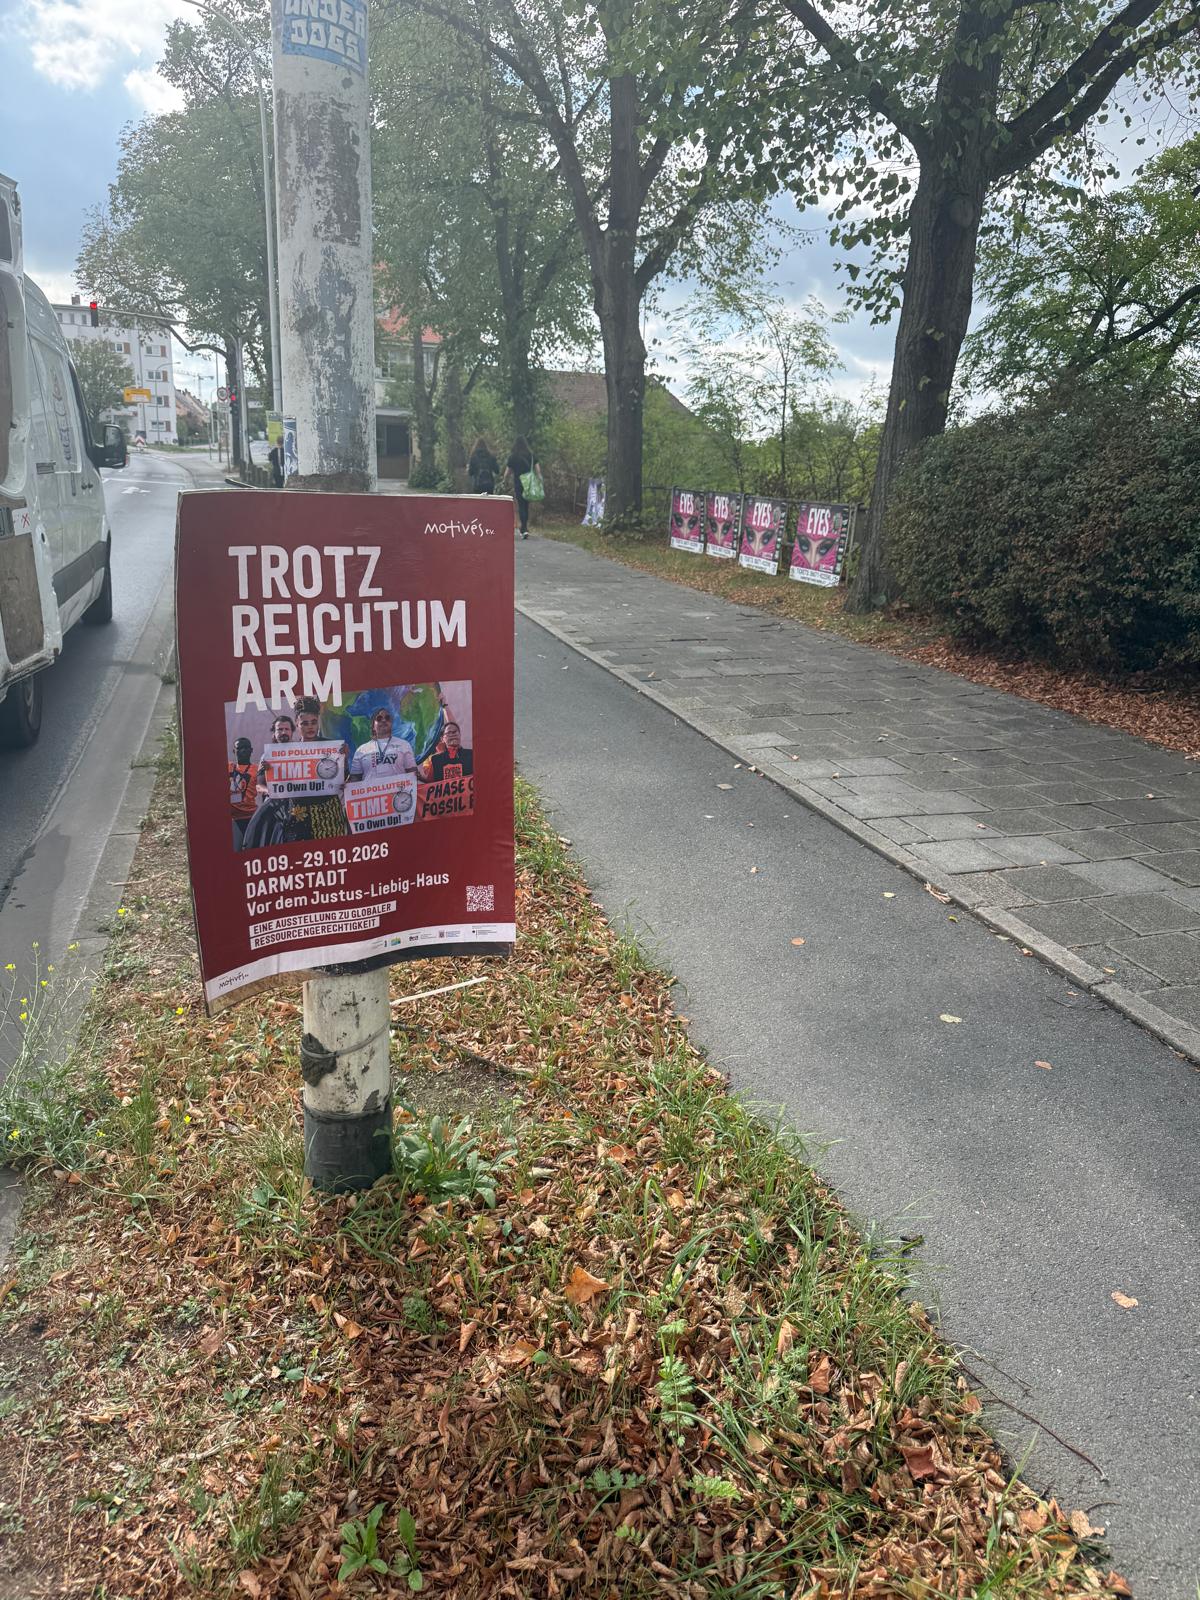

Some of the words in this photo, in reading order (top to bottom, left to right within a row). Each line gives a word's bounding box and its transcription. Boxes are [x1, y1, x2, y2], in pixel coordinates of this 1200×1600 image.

[290, 18, 361, 63] DOGS
[680, 493, 694, 515] EYES
[714, 496, 729, 519] EYES
[753, 502, 772, 528] EYES
[806, 508, 831, 537] EYES
[228, 545, 383, 600] TROTZ
[232, 600, 467, 658] REICHTUM
[235, 659, 342, 713] ARM
[272, 760, 313, 780] TIME
[273, 784, 284, 793] To
[287, 782, 307, 793] Own
[309, 781, 325, 791] Up!
[351, 788, 366, 796] BIG
[426, 779, 465, 801] PHASE
[351, 795, 389, 818] TIME
[422, 796, 466, 818] FOSSIL
[354, 822, 365, 832] To
[366, 818, 386, 830] Own
[387, 814, 401, 827] Up!
[244, 841, 389, 877] 10.09.-29.10.2026
[246, 868, 348, 899] DARMSTADT
[247, 901, 272, 917] Vor
[275, 894, 308, 911] dem
[311, 872, 450, 905] Justus-Liebig-Haus
[253, 922, 274, 935] EINE
[275, 911, 337, 929] AUSSTELLUNG
[338, 909, 351, 920] ZU
[352, 903, 392, 918] GLOBALER
[254, 918, 377, 948] RESSOURCENGERECHTIGKEIT
